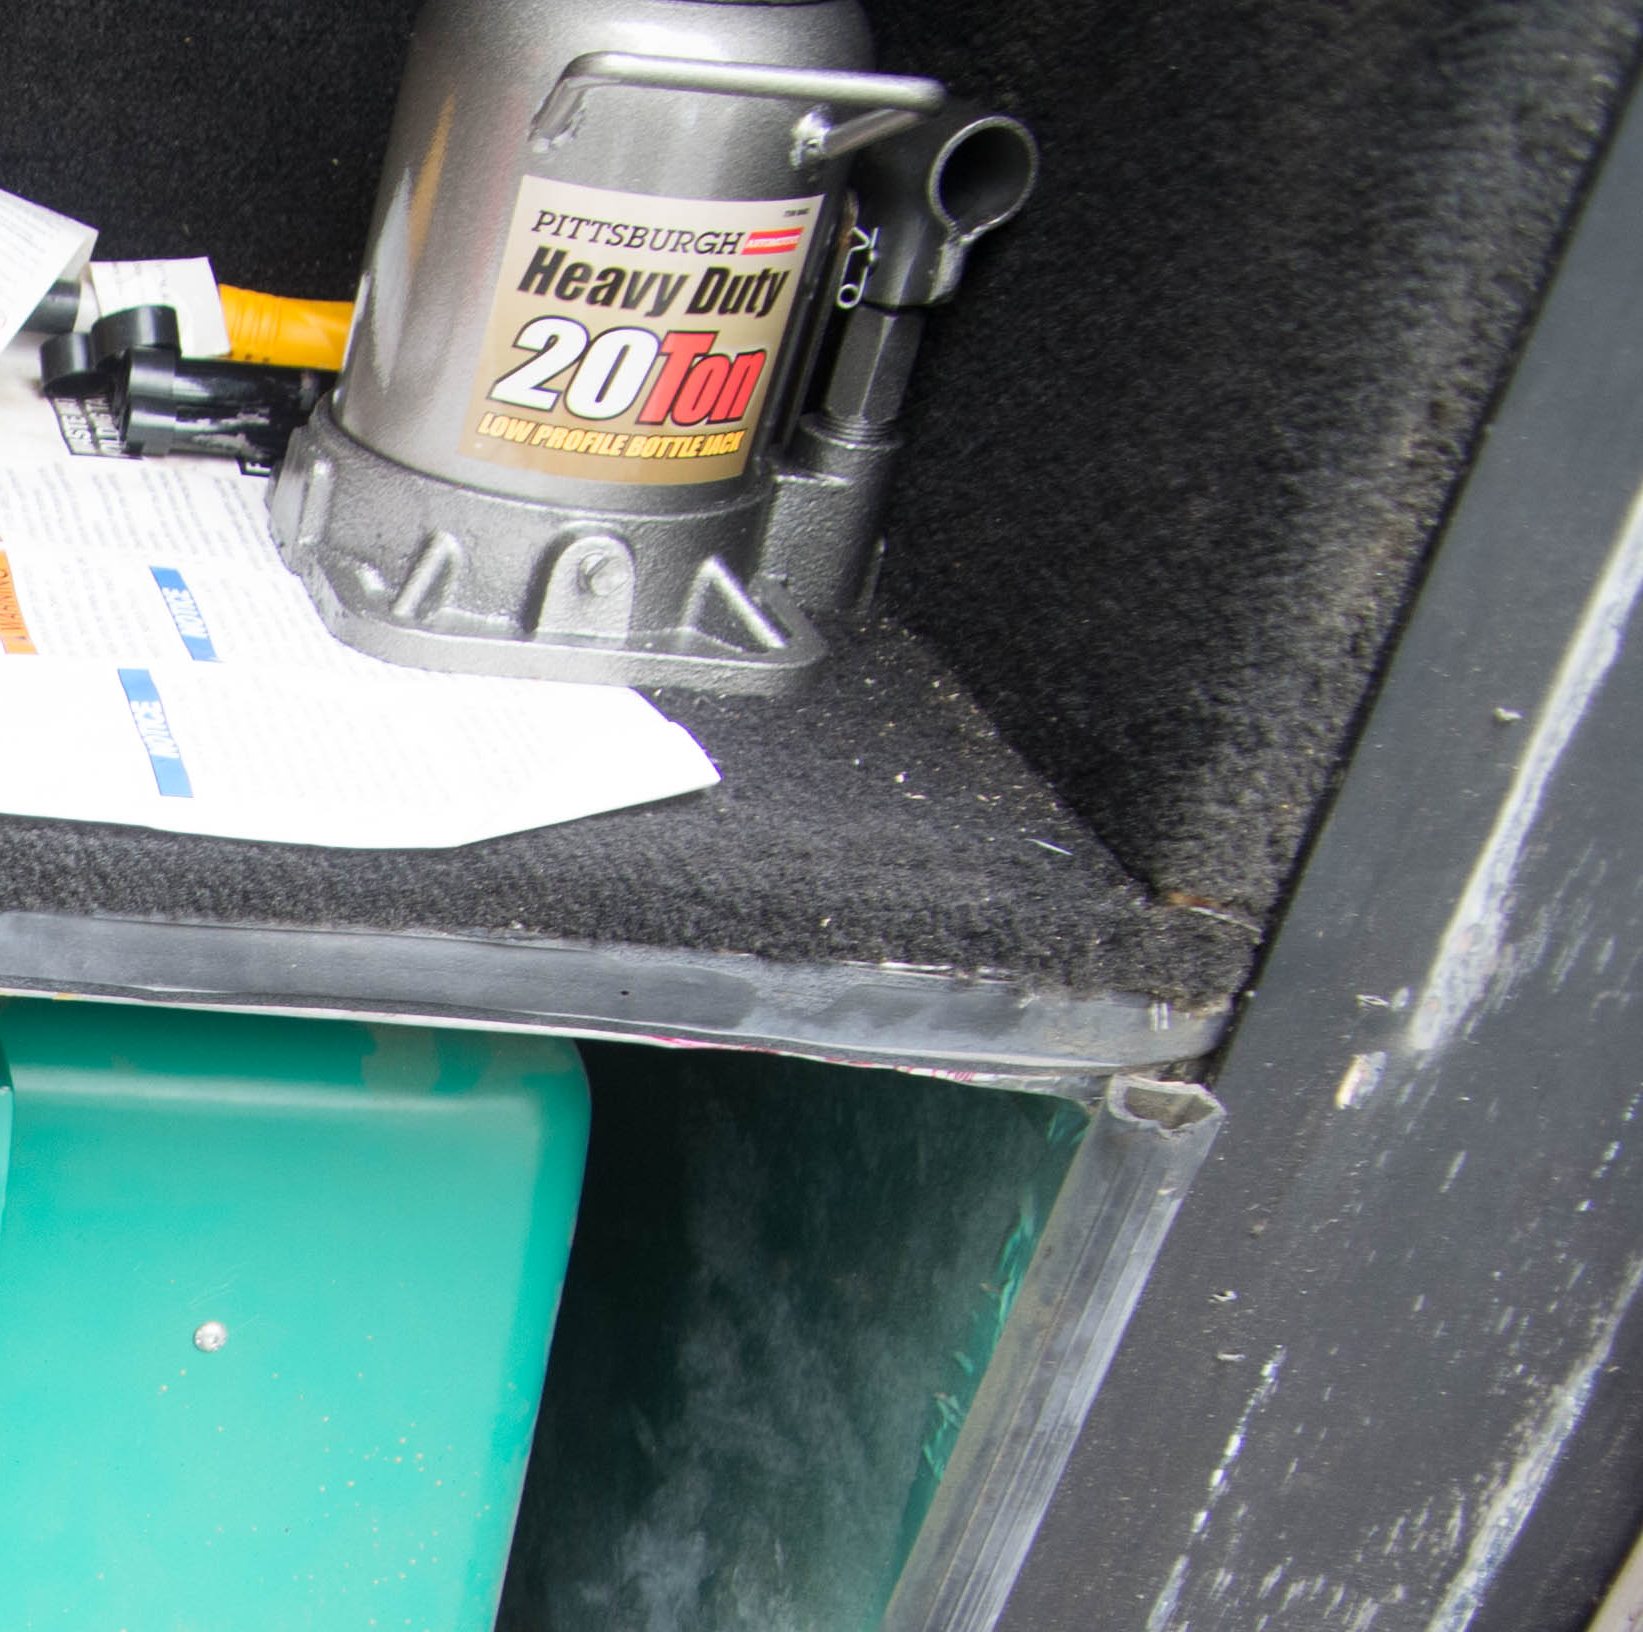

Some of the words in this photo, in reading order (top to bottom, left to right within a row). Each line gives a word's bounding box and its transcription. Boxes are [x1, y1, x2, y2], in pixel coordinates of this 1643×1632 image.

[530, 209, 746, 256] PITTSBURGH
[517, 245, 690, 318] Heavy
[684, 266, 792, 319] Duty
[486, 315, 661, 421] 20
[635, 330, 767, 427] Ton
[477, 411, 534, 444] LOW
[530, 423, 628, 457] PROFILE
[625, 430, 704, 459] BOTTLE
[698, 428, 748, 456] JACK
[130, 698, 182, 760] NOTICE
